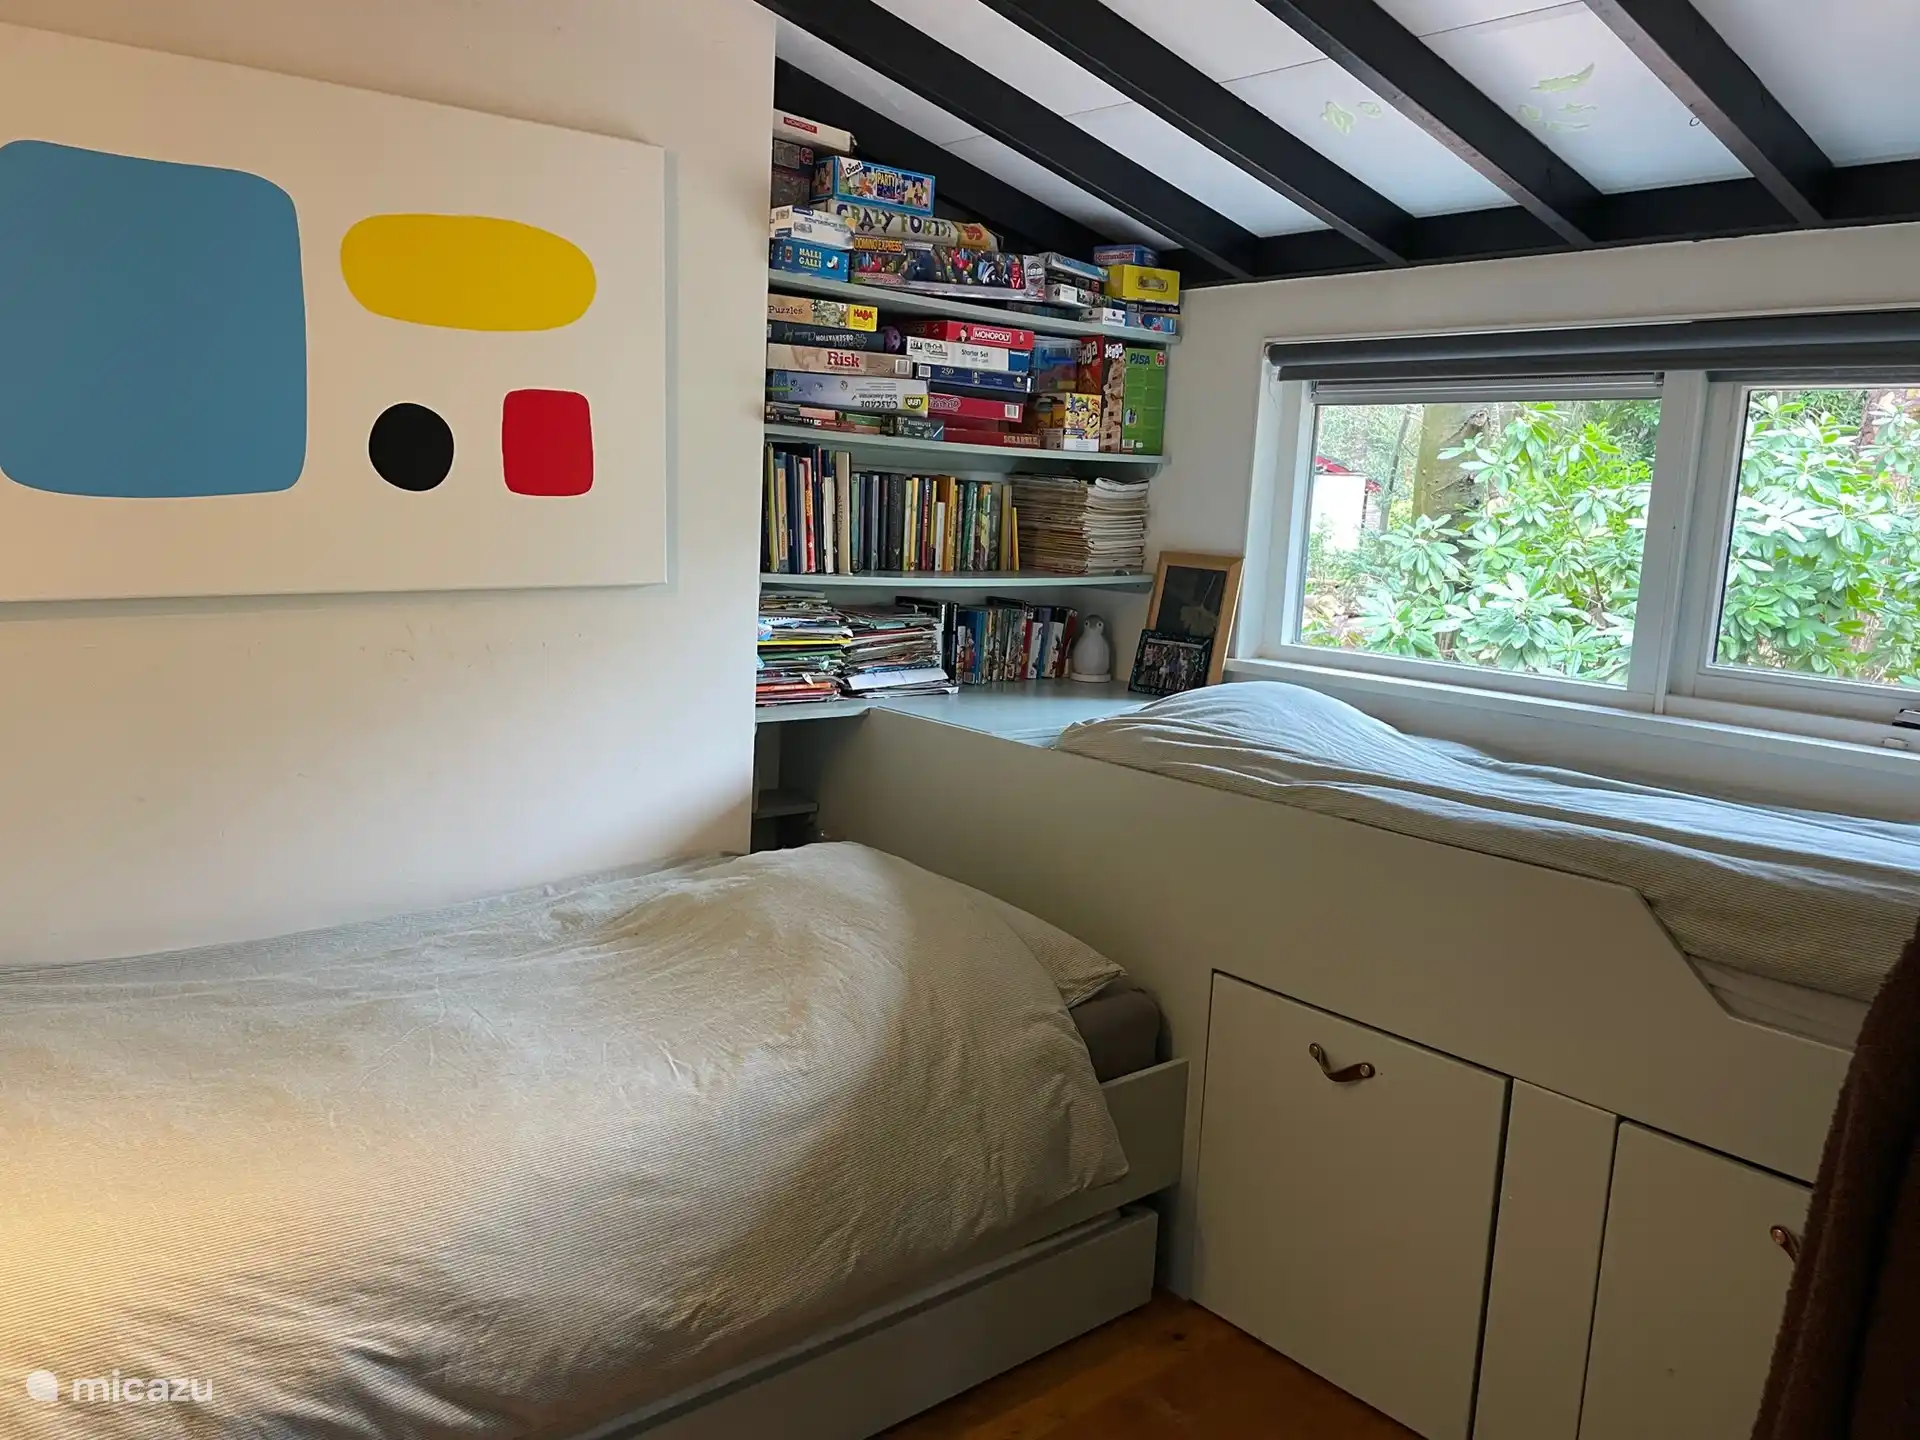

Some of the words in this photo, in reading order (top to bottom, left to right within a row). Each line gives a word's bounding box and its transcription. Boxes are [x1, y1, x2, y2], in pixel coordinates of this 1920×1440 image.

[785, 117, 816, 132] MONOPOLY
[845, 161, 862, 176] Diset
[876, 171, 896, 187] PARTY
[854, 236, 877, 250] DOMINO
[878, 238, 902, 252] EXPRESS
[798, 256, 822, 269] GALLI
[767, 305, 803, 315] Puzzles
[853, 308, 874, 320] HABA
[974, 331, 1011, 341] MONOPOLY
[1104, 342, 1123, 359] Jenga
[827, 350, 860, 368] Risk
[1129, 352, 1150, 365] PISA
[941, 367, 954, 375] 250
[1003, 434, 1039, 446] SCRABBLE
